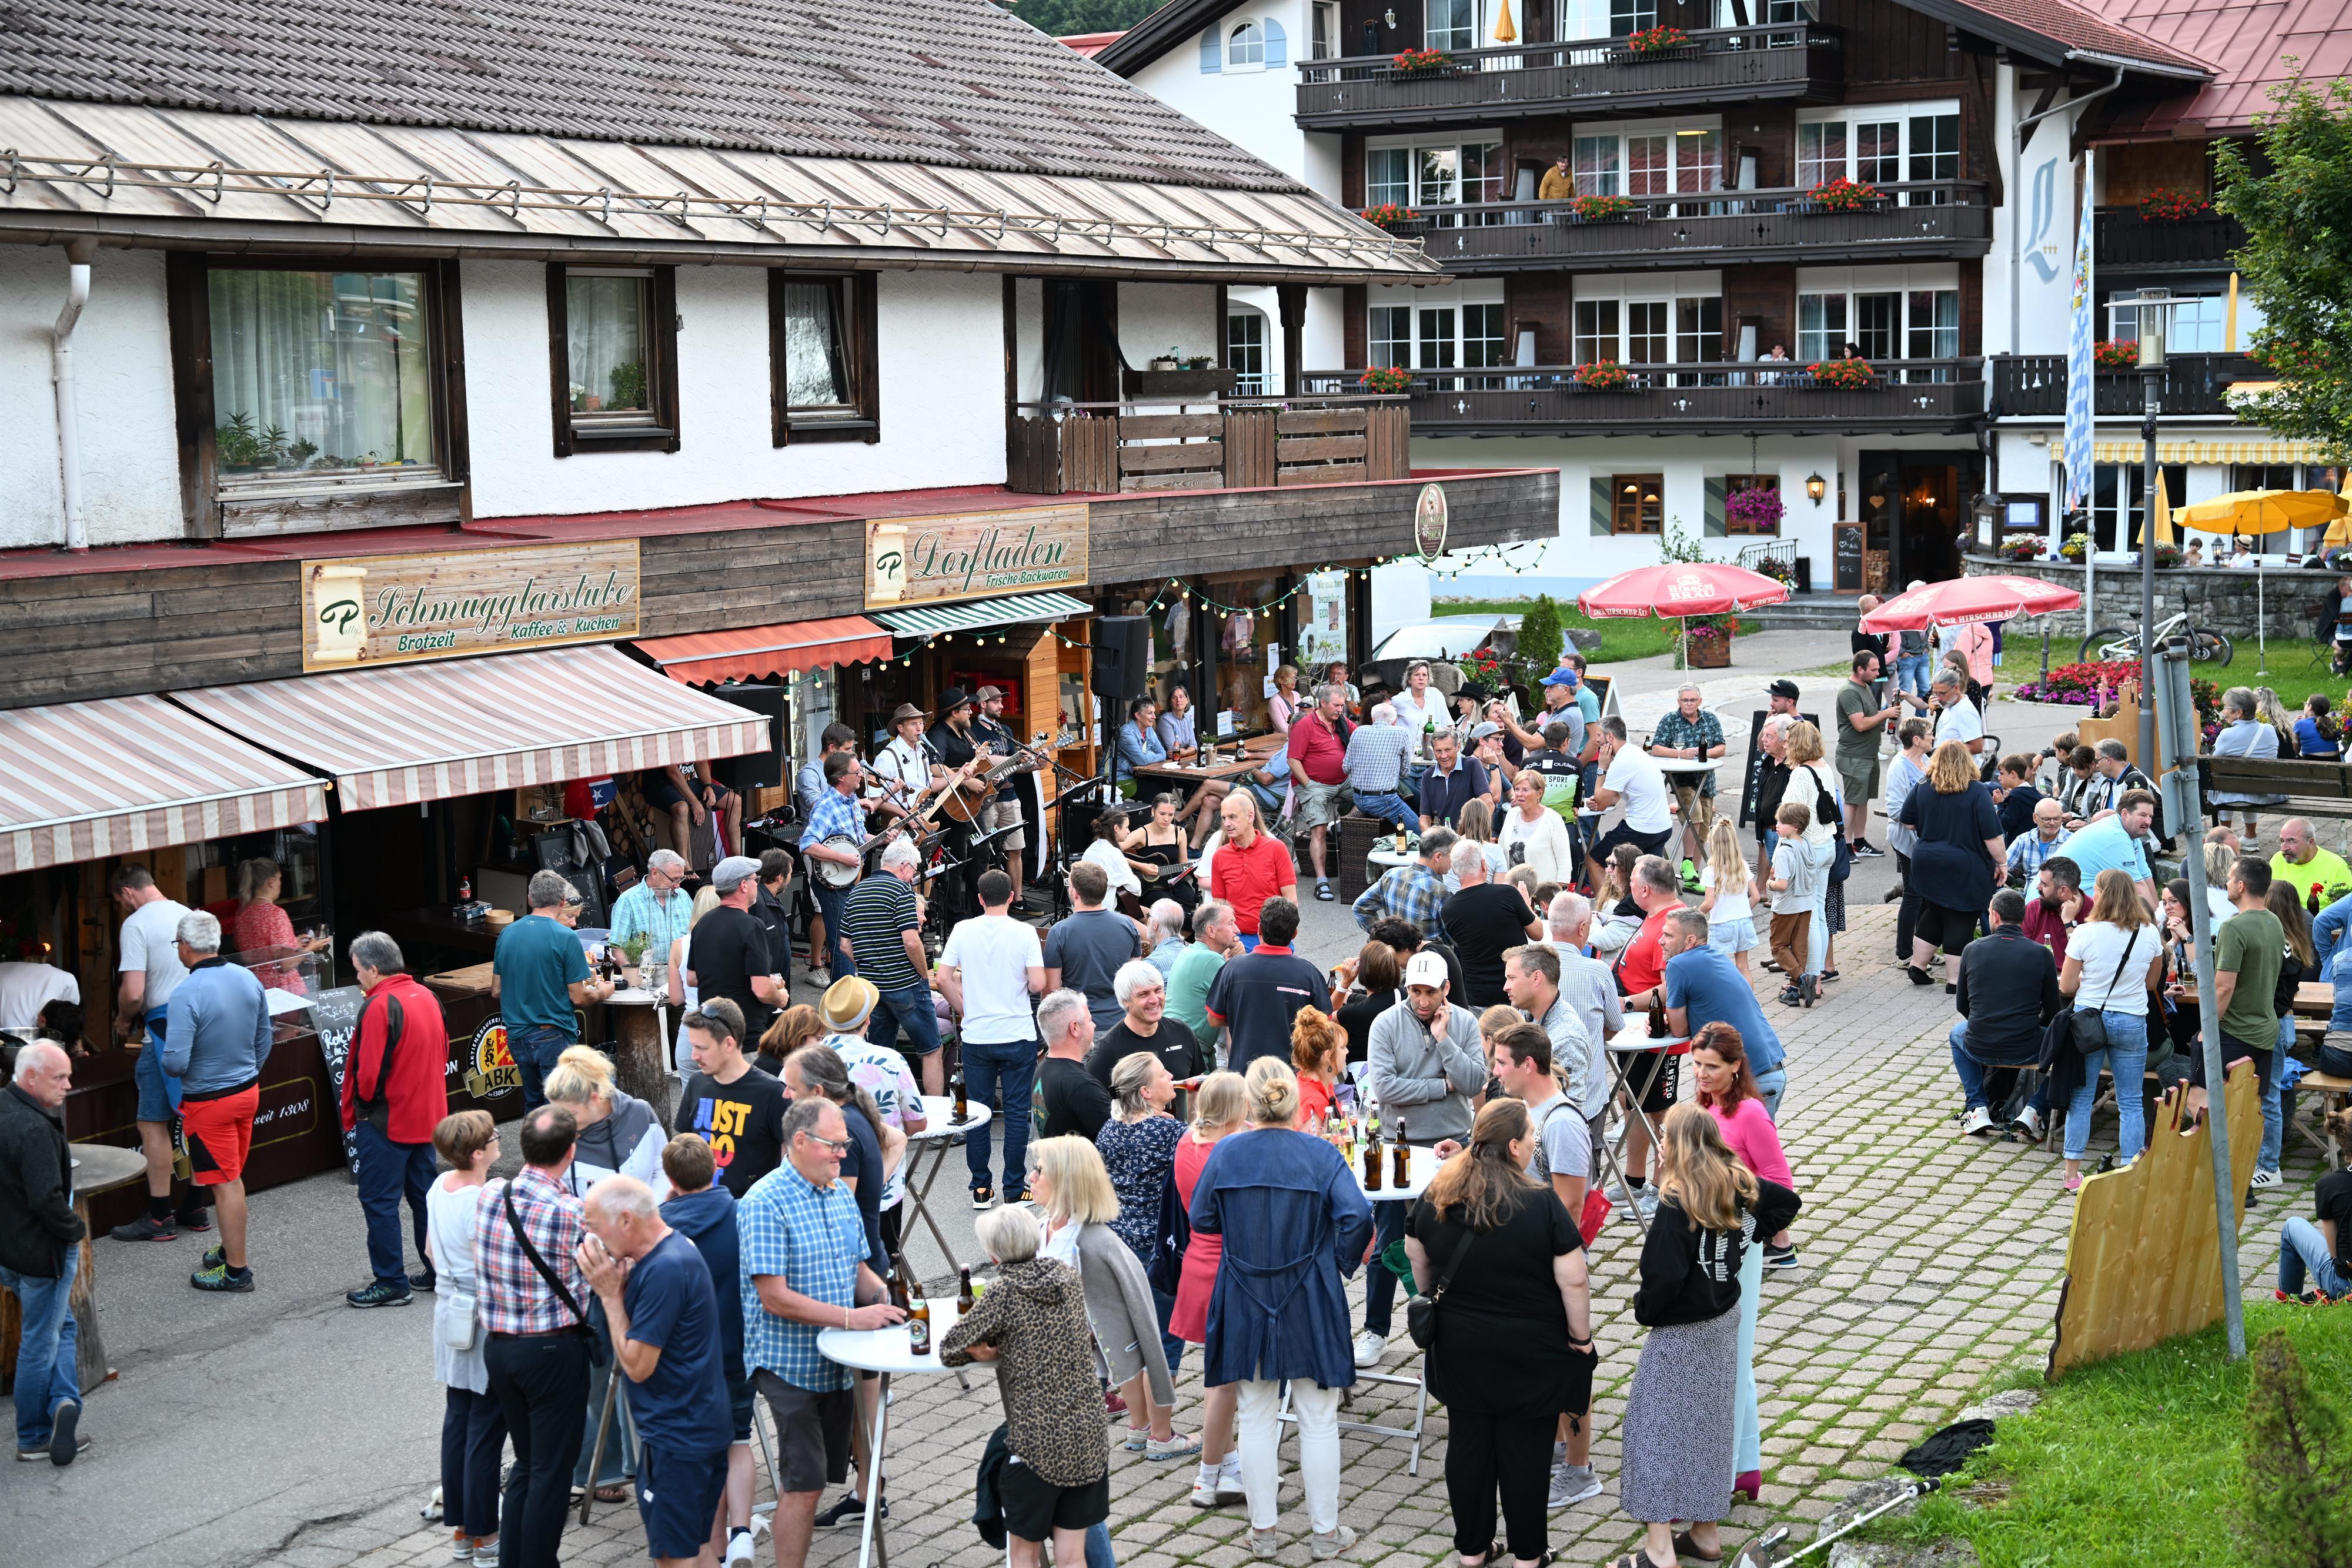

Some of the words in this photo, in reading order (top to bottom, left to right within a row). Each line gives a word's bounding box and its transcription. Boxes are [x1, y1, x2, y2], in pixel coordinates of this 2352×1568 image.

[913, 524, 1071, 593] Dorfladen
[985, 571, 1018, 588] Frische
[1020, 568, 1069, 584] Backwaren
[369, 570, 636, 635] Schmugglarstube
[510, 620, 553, 640] Kaffee
[557, 620, 567, 635] &
[574, 615, 620, 633] Kuchen
[1958, 609, 2016, 623] HIRSCHBRÄU
[397, 630, 456, 652] Brotzeit
[1553, 762, 1576, 770] outlet
[470, 1018, 500, 1066] AKTIENBRAUEREI
[485, 1068, 517, 1092] ABK
[1665, 1068, 1675, 1099] OCEAN
[253, 1109, 275, 1125] seit
[279, 1098, 309, 1118] 1308
[693, 1098, 753, 1136] JUST
